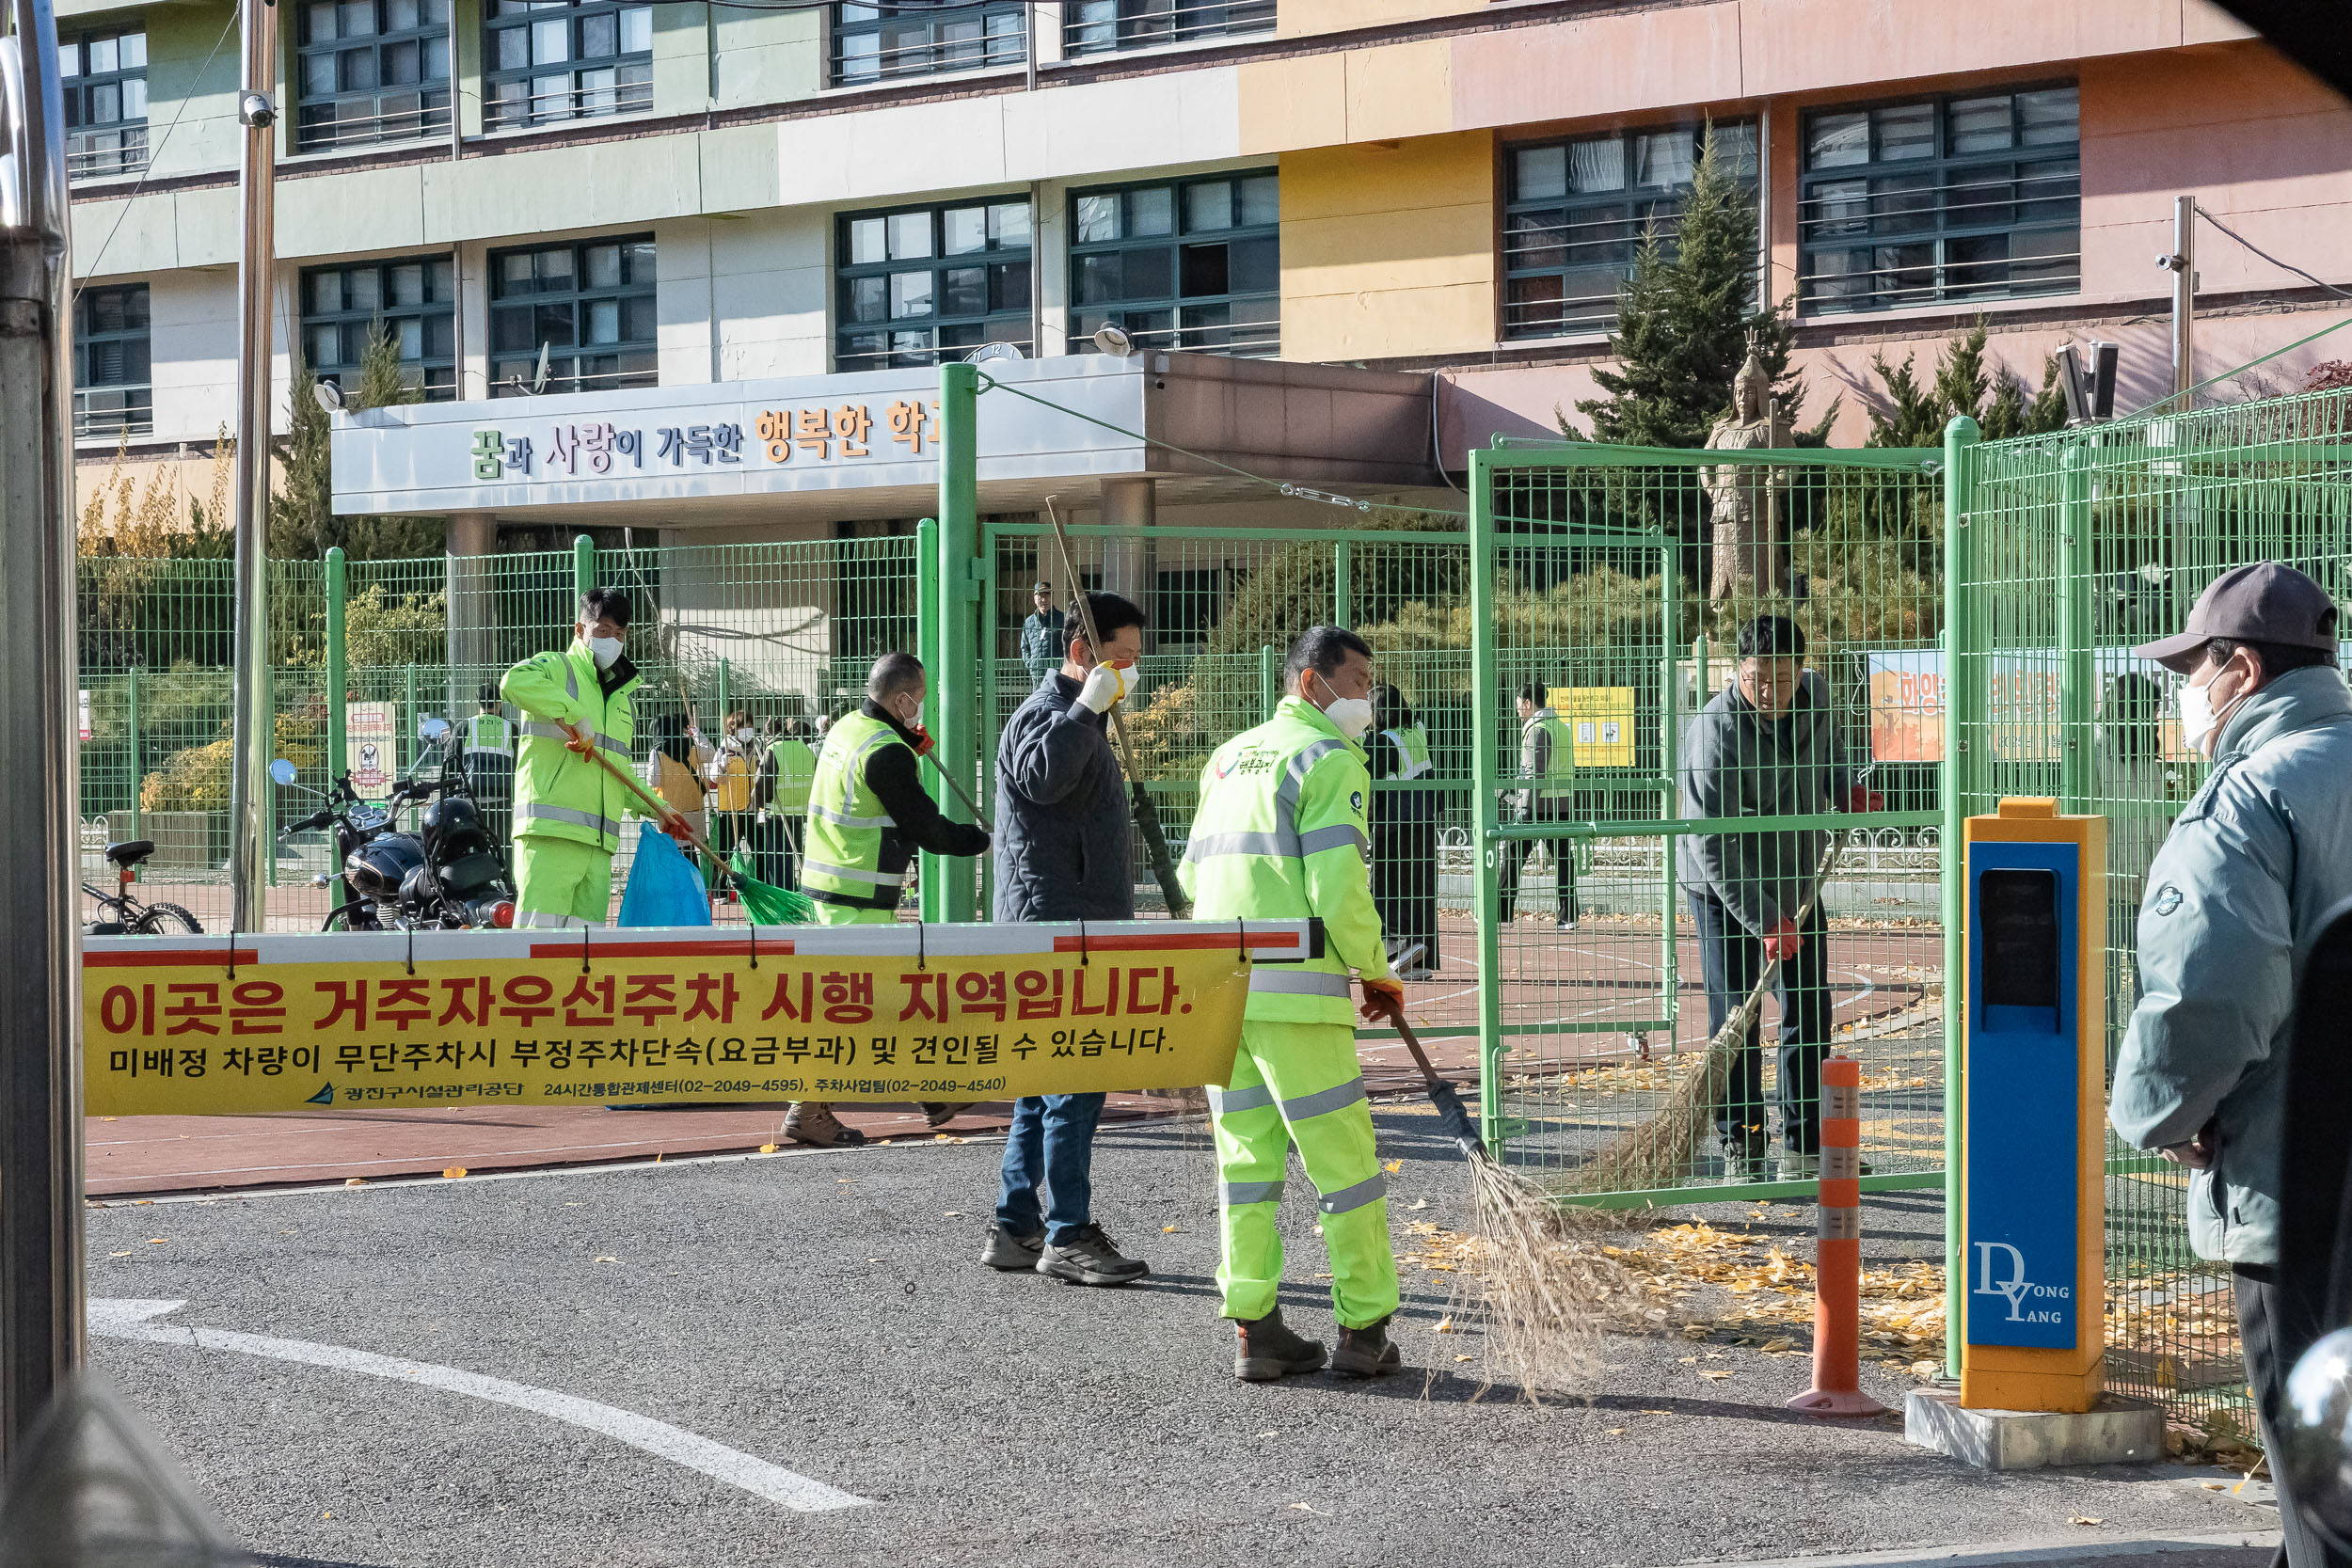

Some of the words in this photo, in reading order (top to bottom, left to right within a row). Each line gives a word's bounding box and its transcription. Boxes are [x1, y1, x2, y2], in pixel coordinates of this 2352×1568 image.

[972, 351, 982, 362] 11
[991, 344, 1002, 355] 12
[470, 430, 533, 479] 꿈과
[546, 422, 643, 474] 사랑이
[657, 422, 744, 467] 가득한
[755, 404, 873, 464] 행복한
[1900, 670, 1946, 716] 화양
[100, 980, 287, 1037] 이곳은
[313, 972, 740, 1032] 거주자우선주차
[761, 971, 875, 1024] 시행
[898, 966, 1193, 1024] 지역입니다.
[109, 1047, 208, 1078] 미배정
[222, 1044, 320, 1077] 차량이
[334, 1038, 497, 1074] 무단주차시
[510, 1035, 857, 1069] 부정주차단속(요금부과)
[870, 1035, 898, 1066] 및
[910, 1033, 1000, 1066] 견인될
[1010, 1032, 1039, 1061] 수
[1050, 1026, 1175, 1058] 있습니다.
[343, 1082, 525, 1101] 광진구시설관리공단
[815, 1076, 1007, 1095] 주차사업팀(02-2049-4540)
